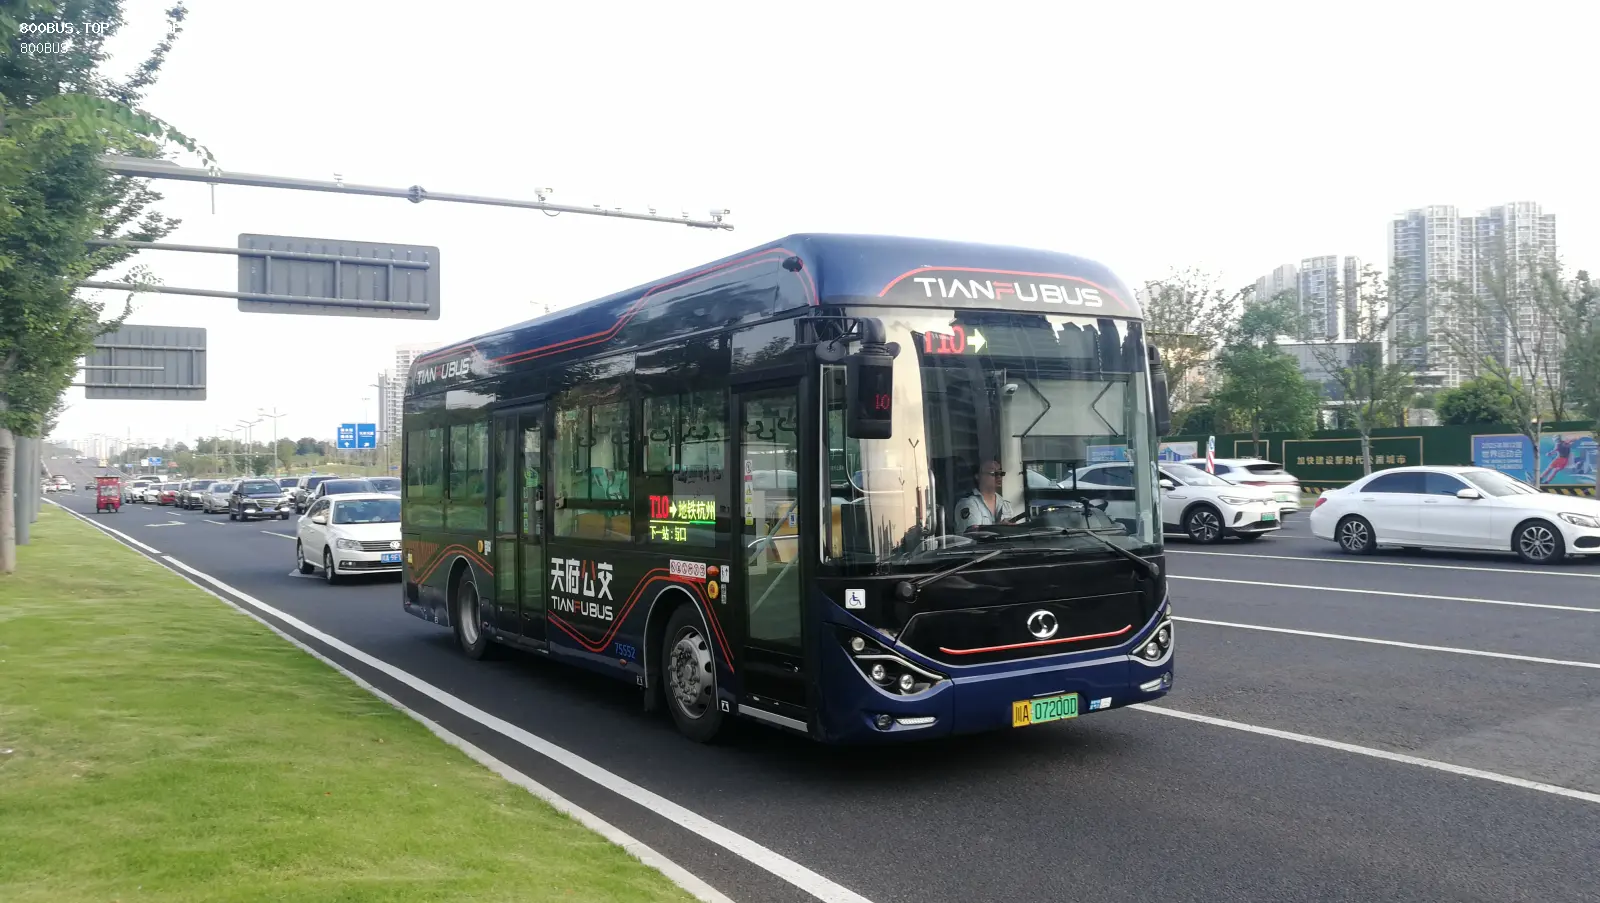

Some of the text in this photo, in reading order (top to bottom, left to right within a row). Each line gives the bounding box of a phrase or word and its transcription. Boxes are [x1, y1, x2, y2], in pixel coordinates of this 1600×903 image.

[913, 277, 1103, 308] TIANFUBUS
[417, 357, 471, 385] TIANFUBUS
[649, 495, 716, 520] T10 地铁杭州
[551, 557, 613, 600] 天府公交
[551, 595, 613, 621] TIANFUBUS
[615, 642, 635, 659] 75552
[1015, 704, 1030, 723] 川A
[1034, 697, 1077, 719] 07200D
